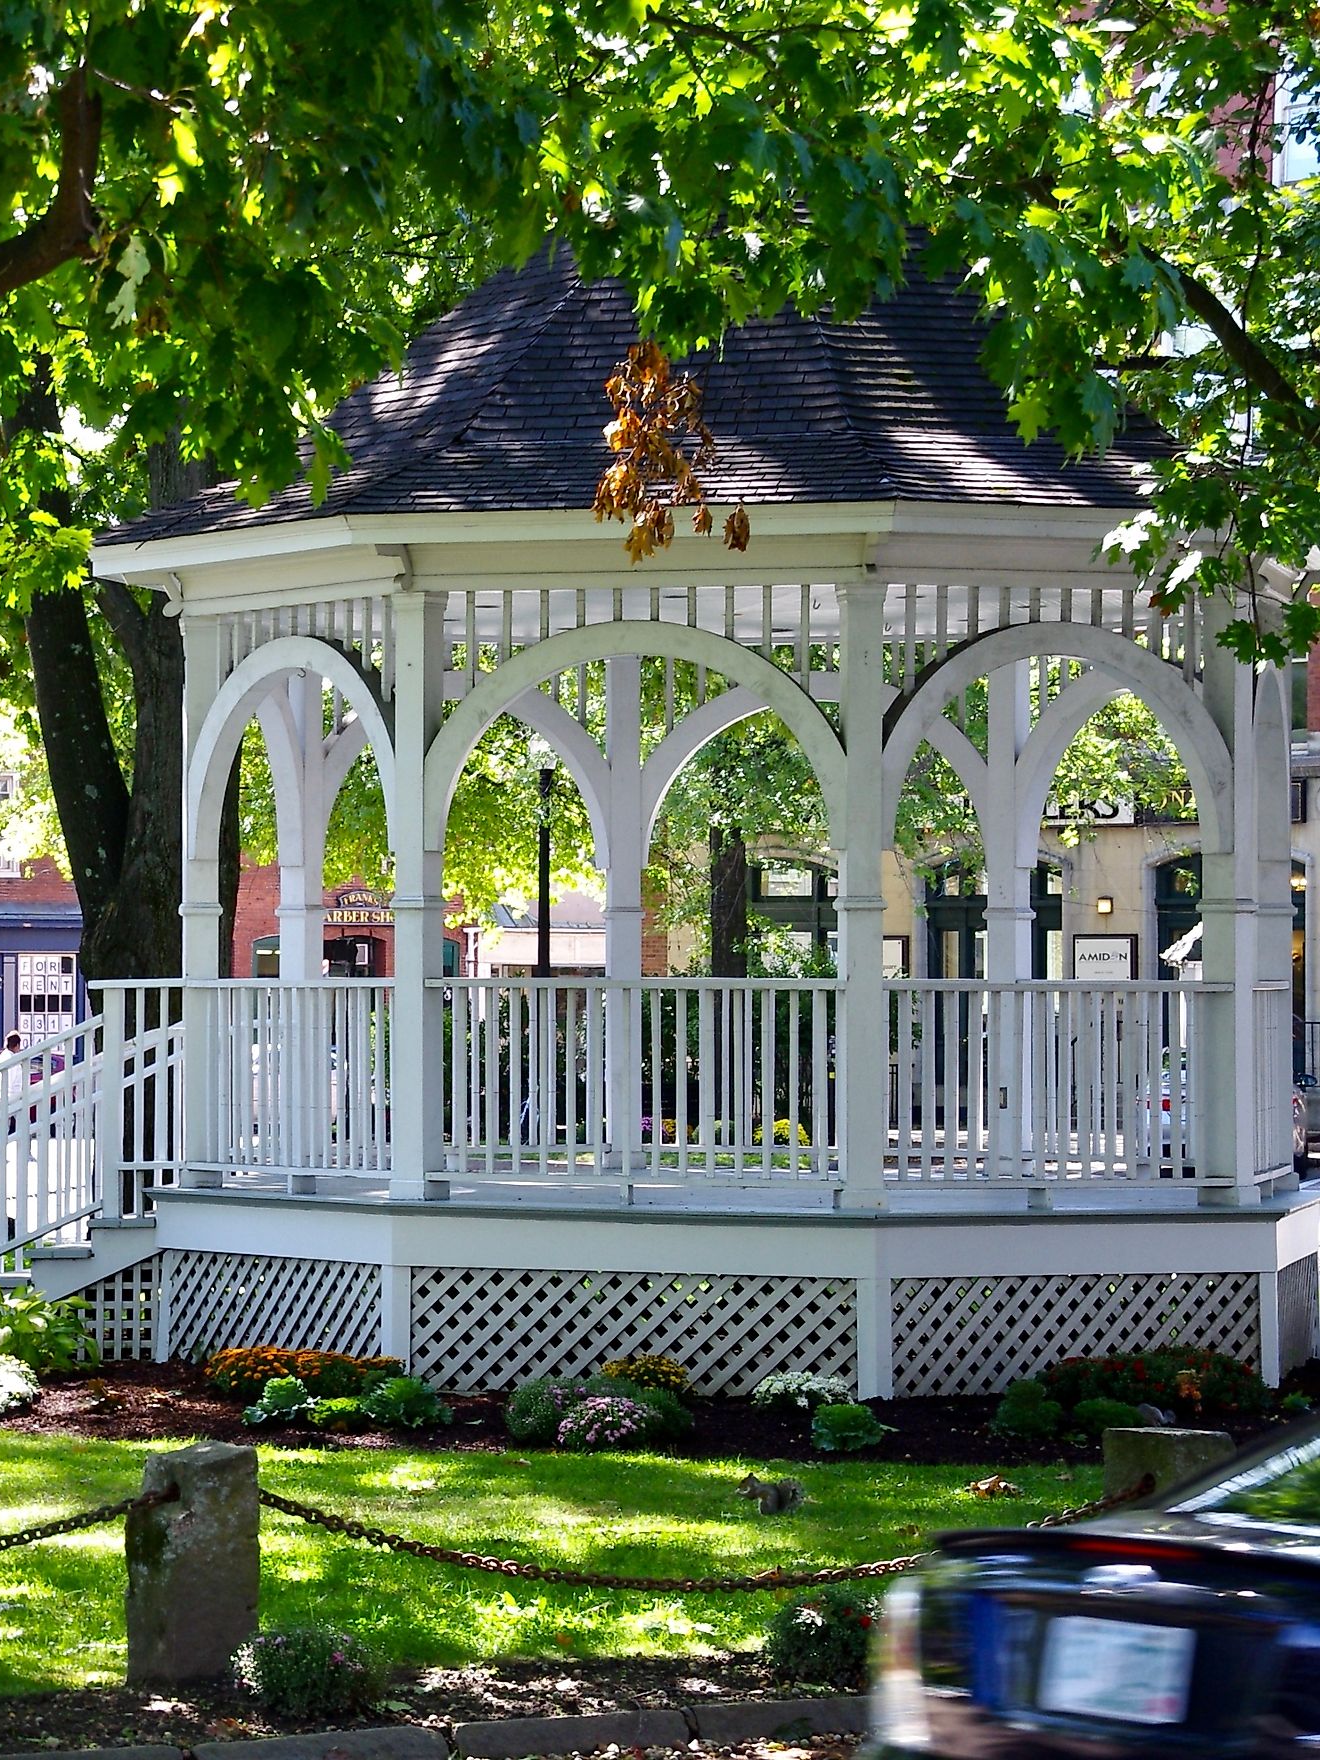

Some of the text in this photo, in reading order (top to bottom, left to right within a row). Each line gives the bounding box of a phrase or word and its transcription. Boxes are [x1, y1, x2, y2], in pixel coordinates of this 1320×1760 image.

[323, 910, 395, 923] ARBER SH
[22, 961, 57, 972] FOR
[22, 980, 70, 991] RENT
